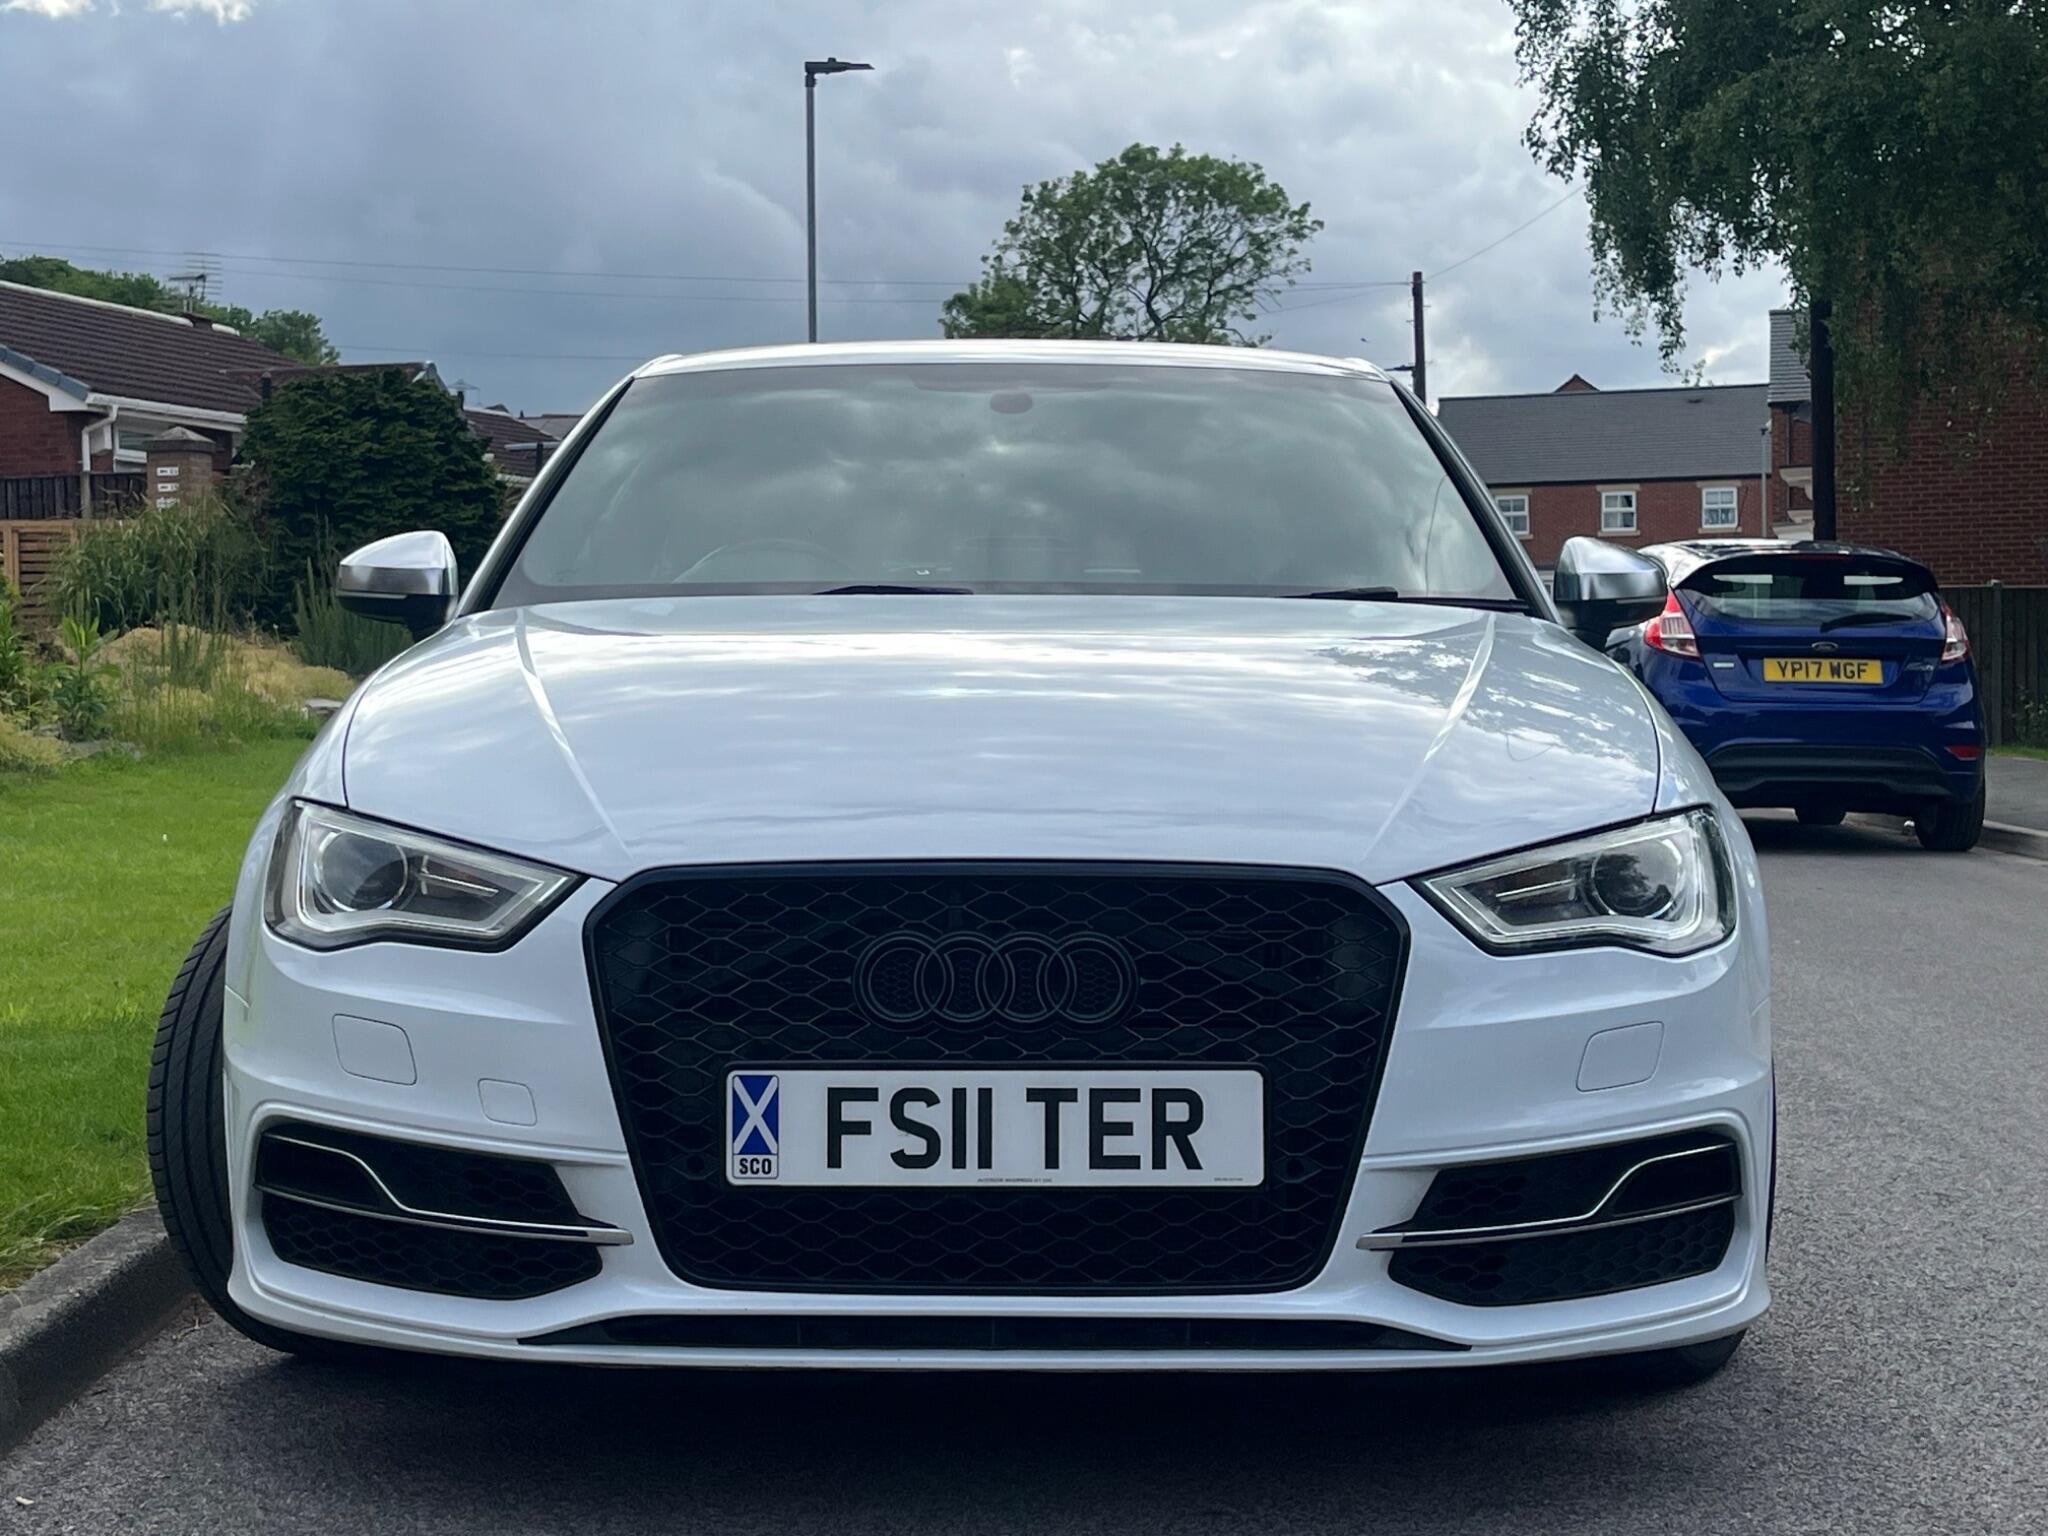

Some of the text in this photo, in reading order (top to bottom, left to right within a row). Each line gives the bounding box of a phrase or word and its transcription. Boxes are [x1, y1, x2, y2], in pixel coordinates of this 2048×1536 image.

[1777, 660, 1869, 679] YP17 WGF
[1026, 1087, 1205, 1170] TER
[739, 1157, 772, 1175] SCO
